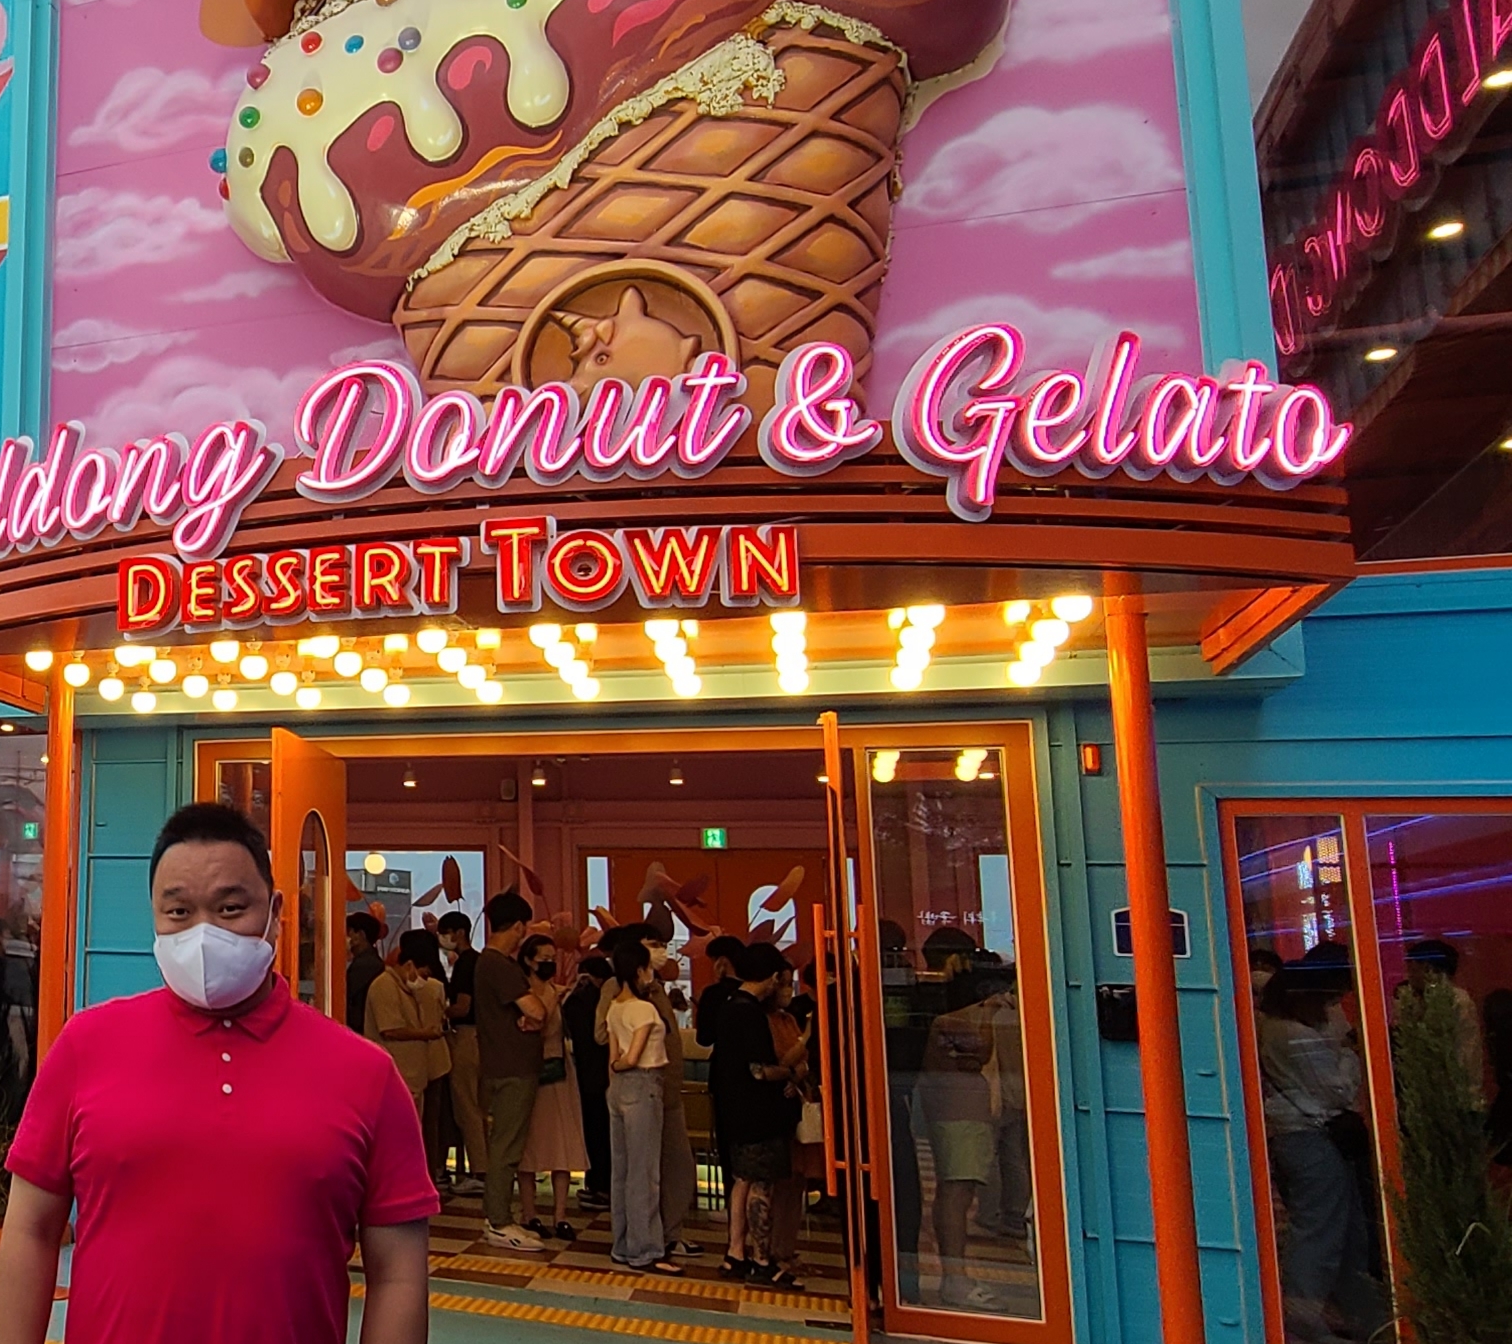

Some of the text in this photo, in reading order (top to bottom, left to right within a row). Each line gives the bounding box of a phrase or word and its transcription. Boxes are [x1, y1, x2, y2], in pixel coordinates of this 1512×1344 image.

[293, 353, 748, 494] Donut
[768, 342, 881, 464] &
[908, 322, 1353, 509] Gelato
[118, 516, 797, 632] DESSERT TOWN
